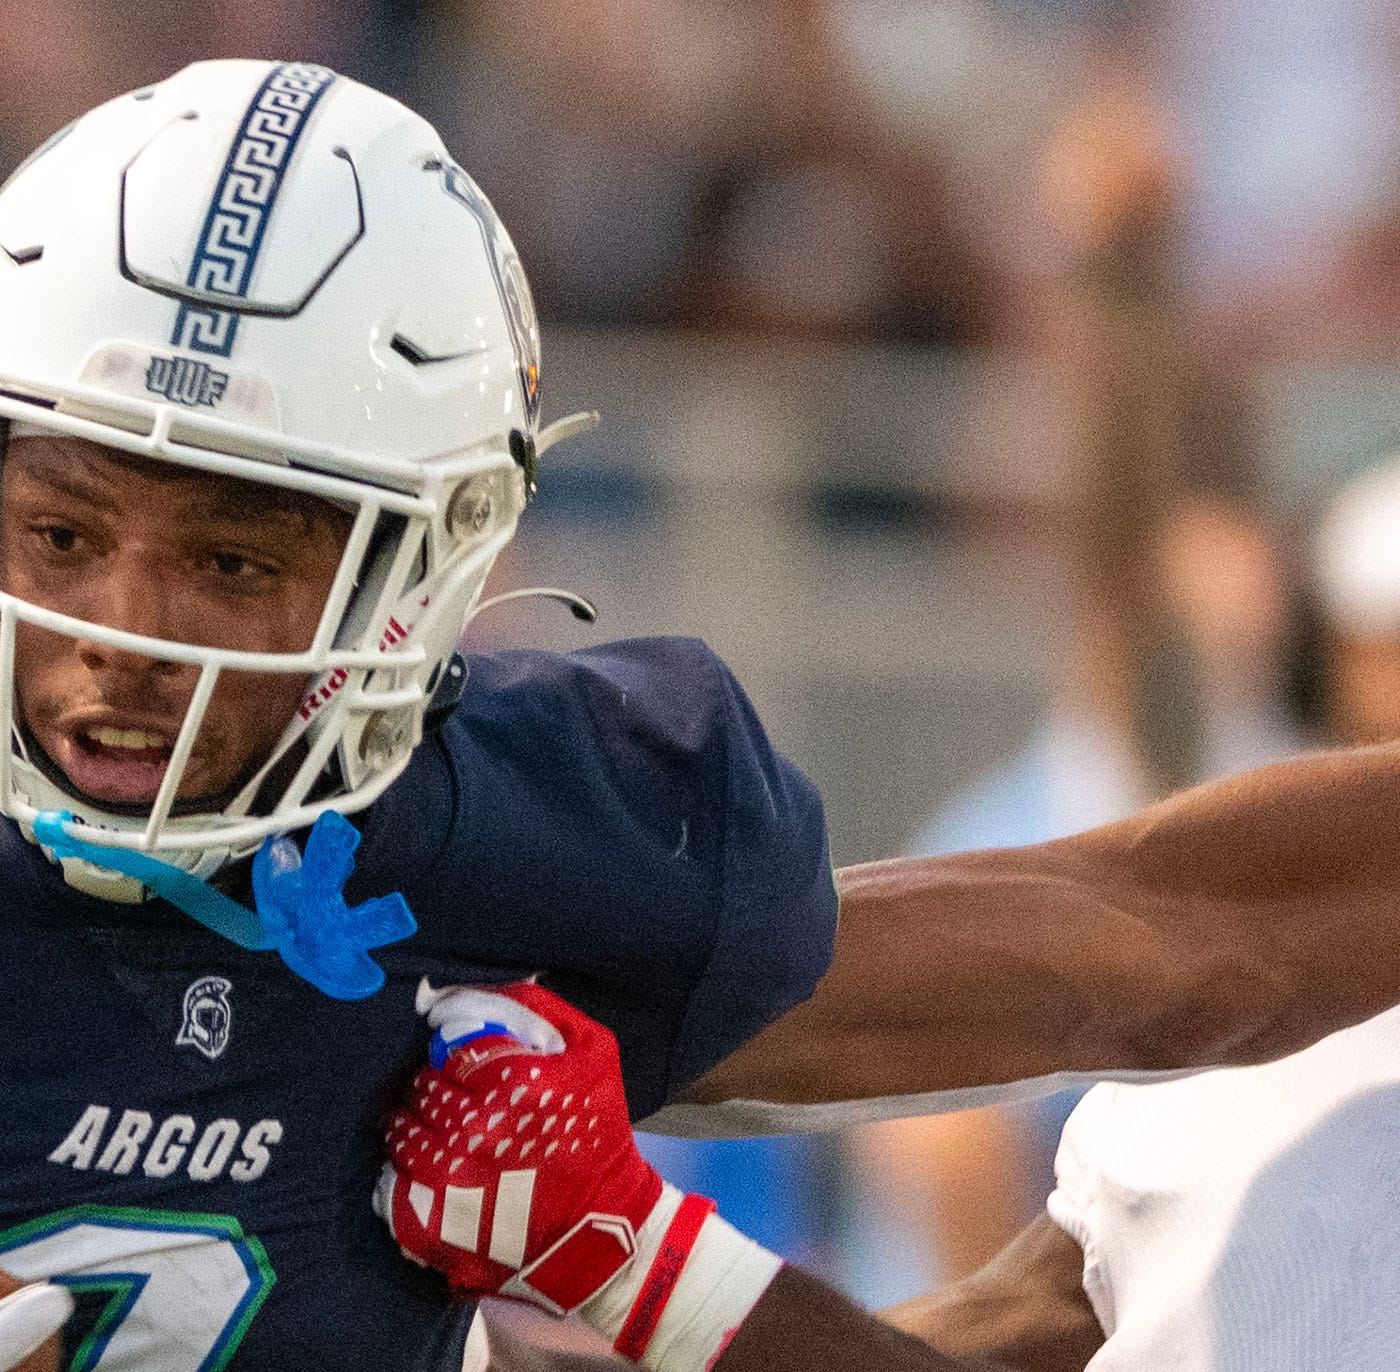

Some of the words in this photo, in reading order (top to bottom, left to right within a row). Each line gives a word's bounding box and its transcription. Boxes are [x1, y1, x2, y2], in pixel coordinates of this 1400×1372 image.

[145, 356, 228, 408] UWF
[300, 615, 408, 720] Ridll
[49, 1104, 283, 1182] ARGOS
